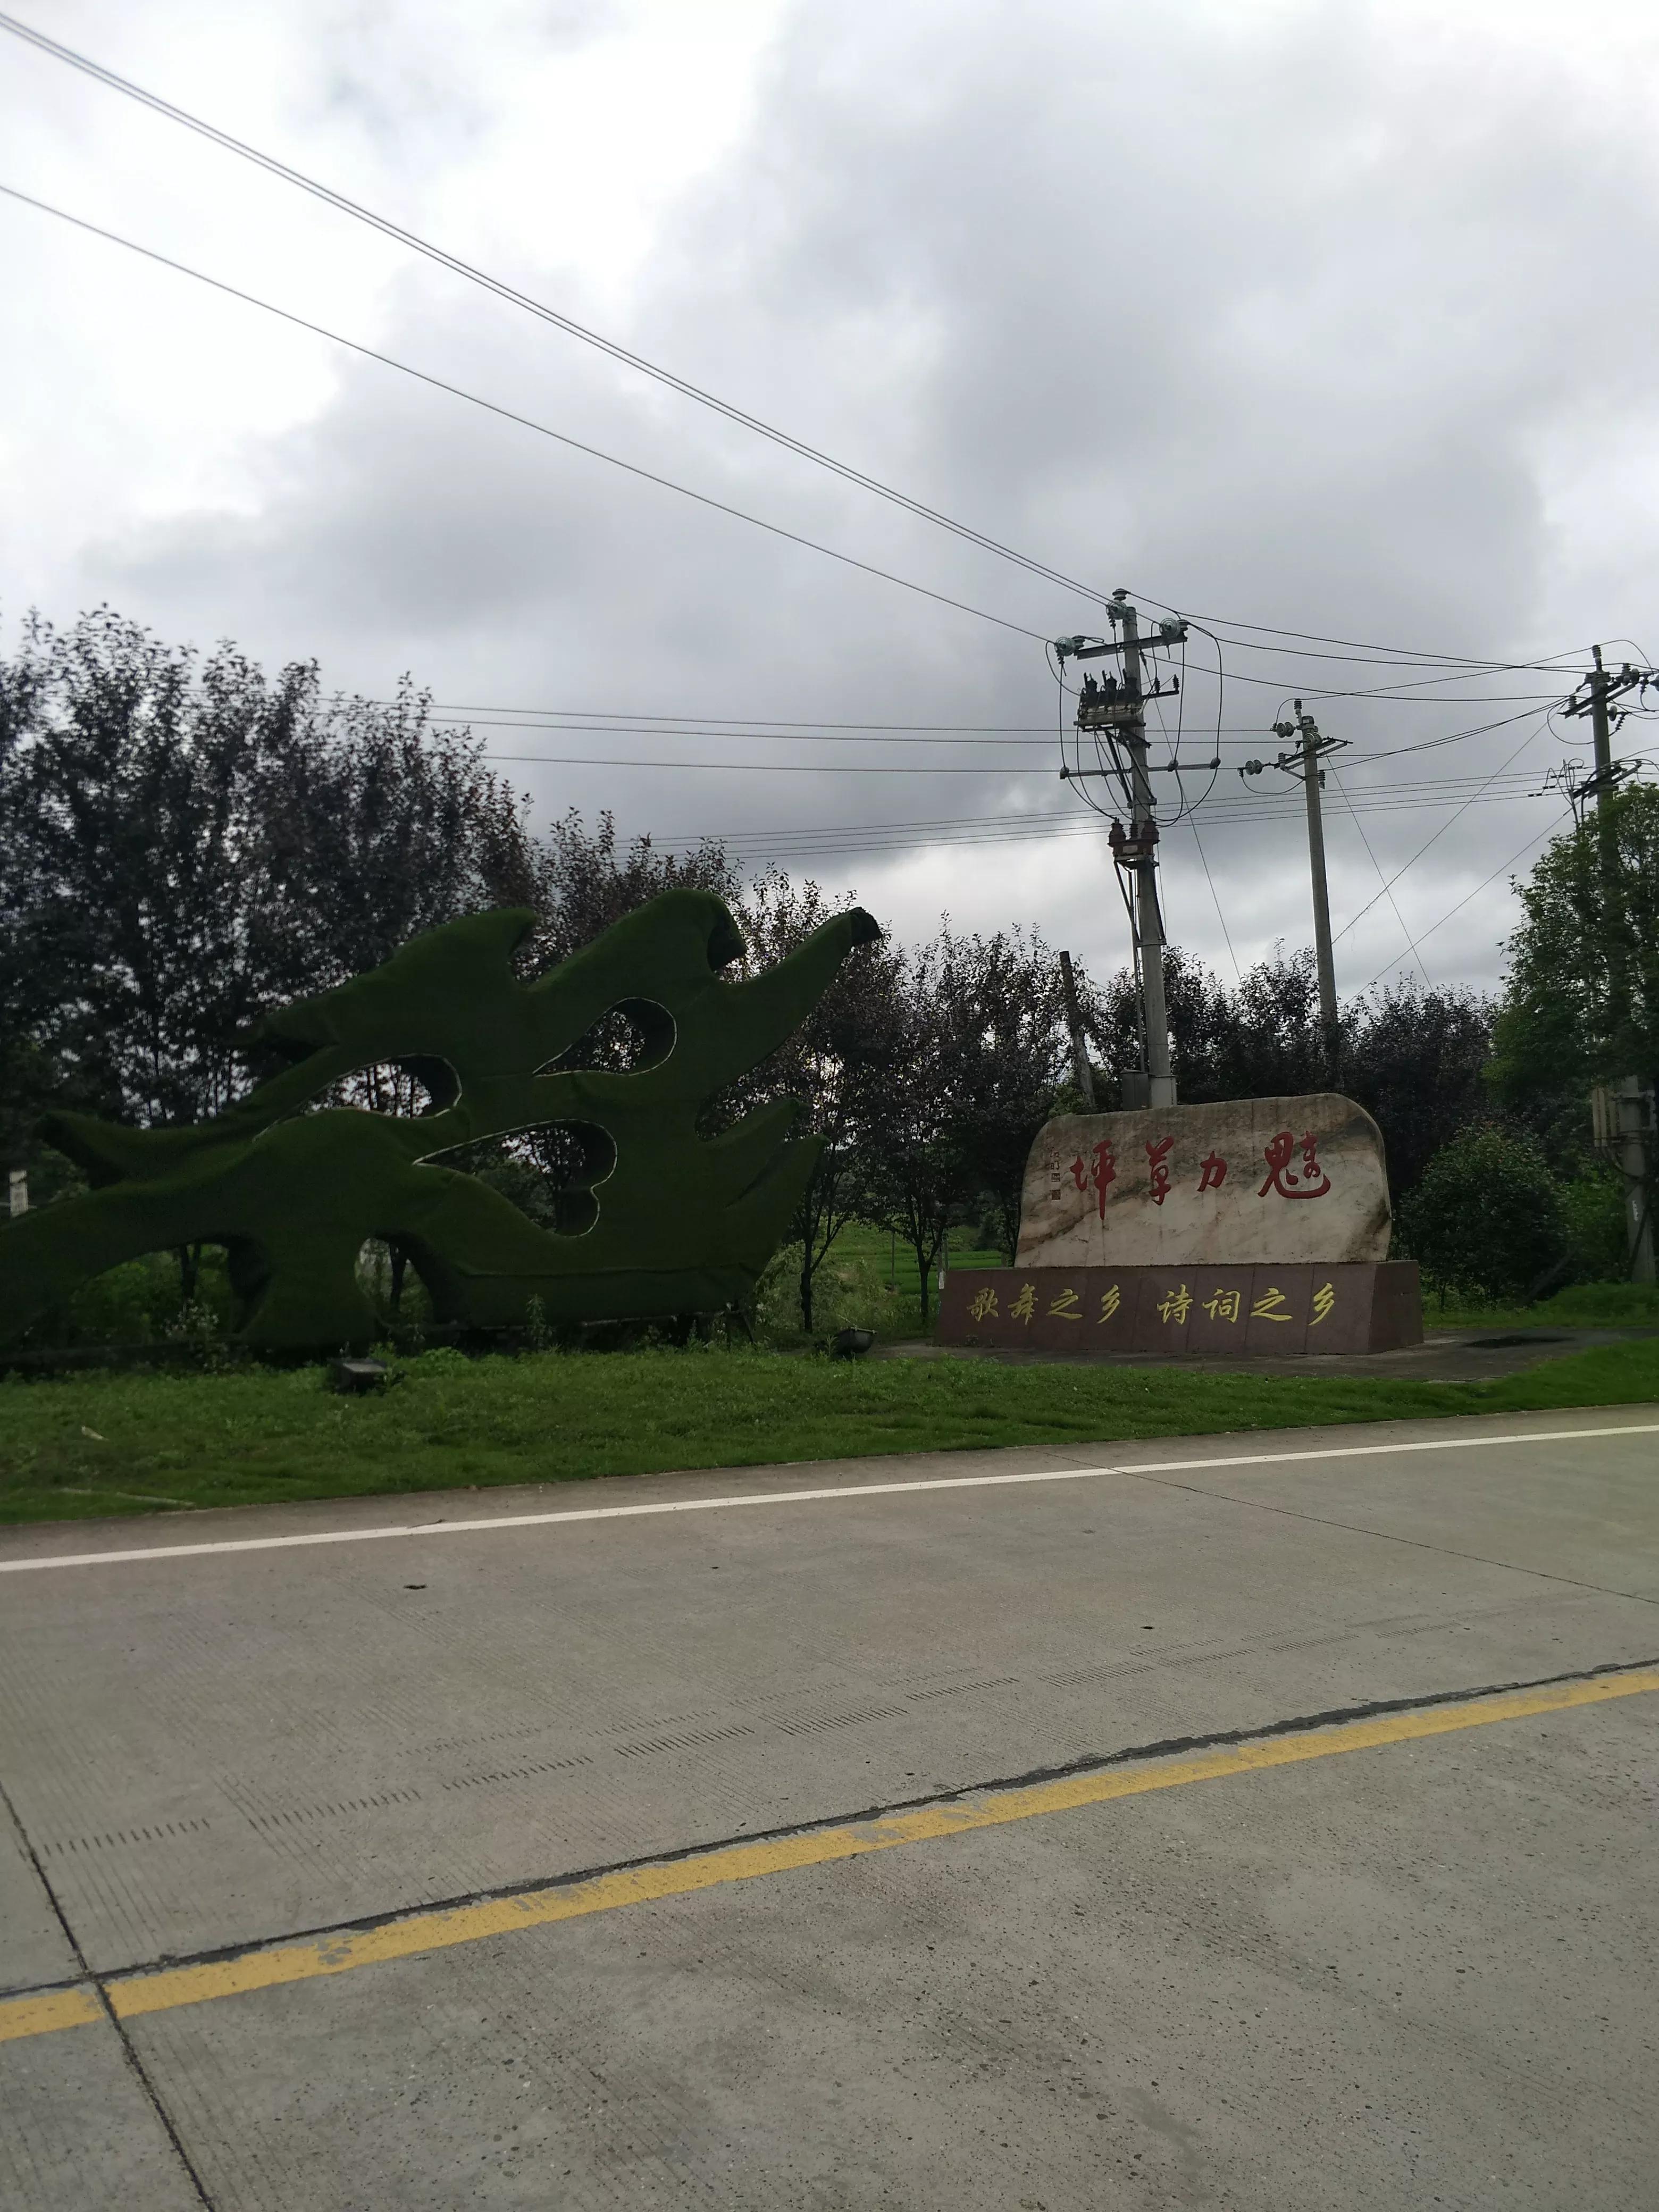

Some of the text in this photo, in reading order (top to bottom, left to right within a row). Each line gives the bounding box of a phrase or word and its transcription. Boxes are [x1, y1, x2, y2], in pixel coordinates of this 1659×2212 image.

[966, 1282, 1336, 1326] 歌舞之乡 诗词之乡
